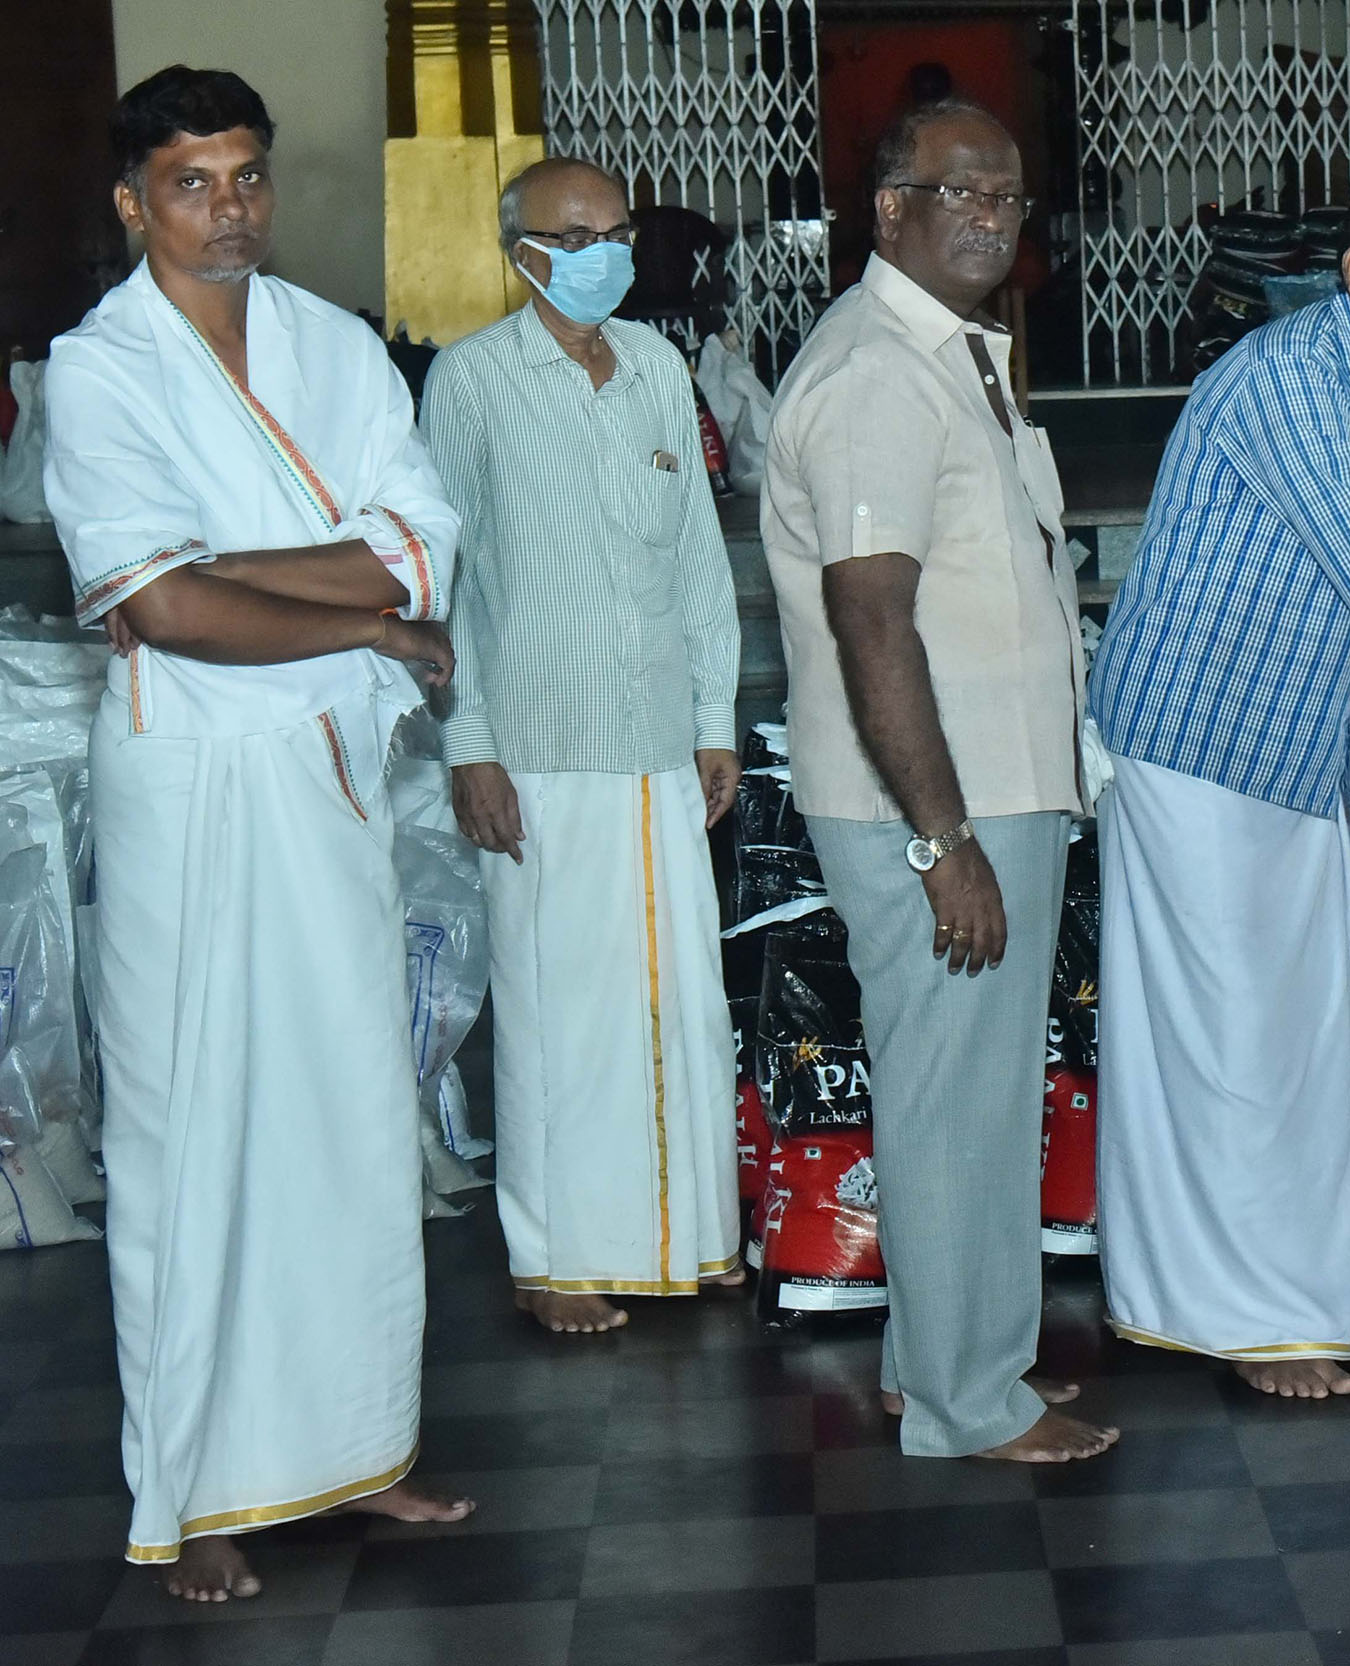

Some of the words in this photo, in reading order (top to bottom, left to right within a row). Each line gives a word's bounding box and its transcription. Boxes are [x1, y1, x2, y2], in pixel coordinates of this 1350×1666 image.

[810, 1106, 867, 1125] Lachkari
[1052, 1222, 1093, 1233] PRODUCE
[791, 1276, 834, 1287] PRODUCE
[834, 1279, 848, 1287] OF
[849, 1280, 875, 1288] INDIA
